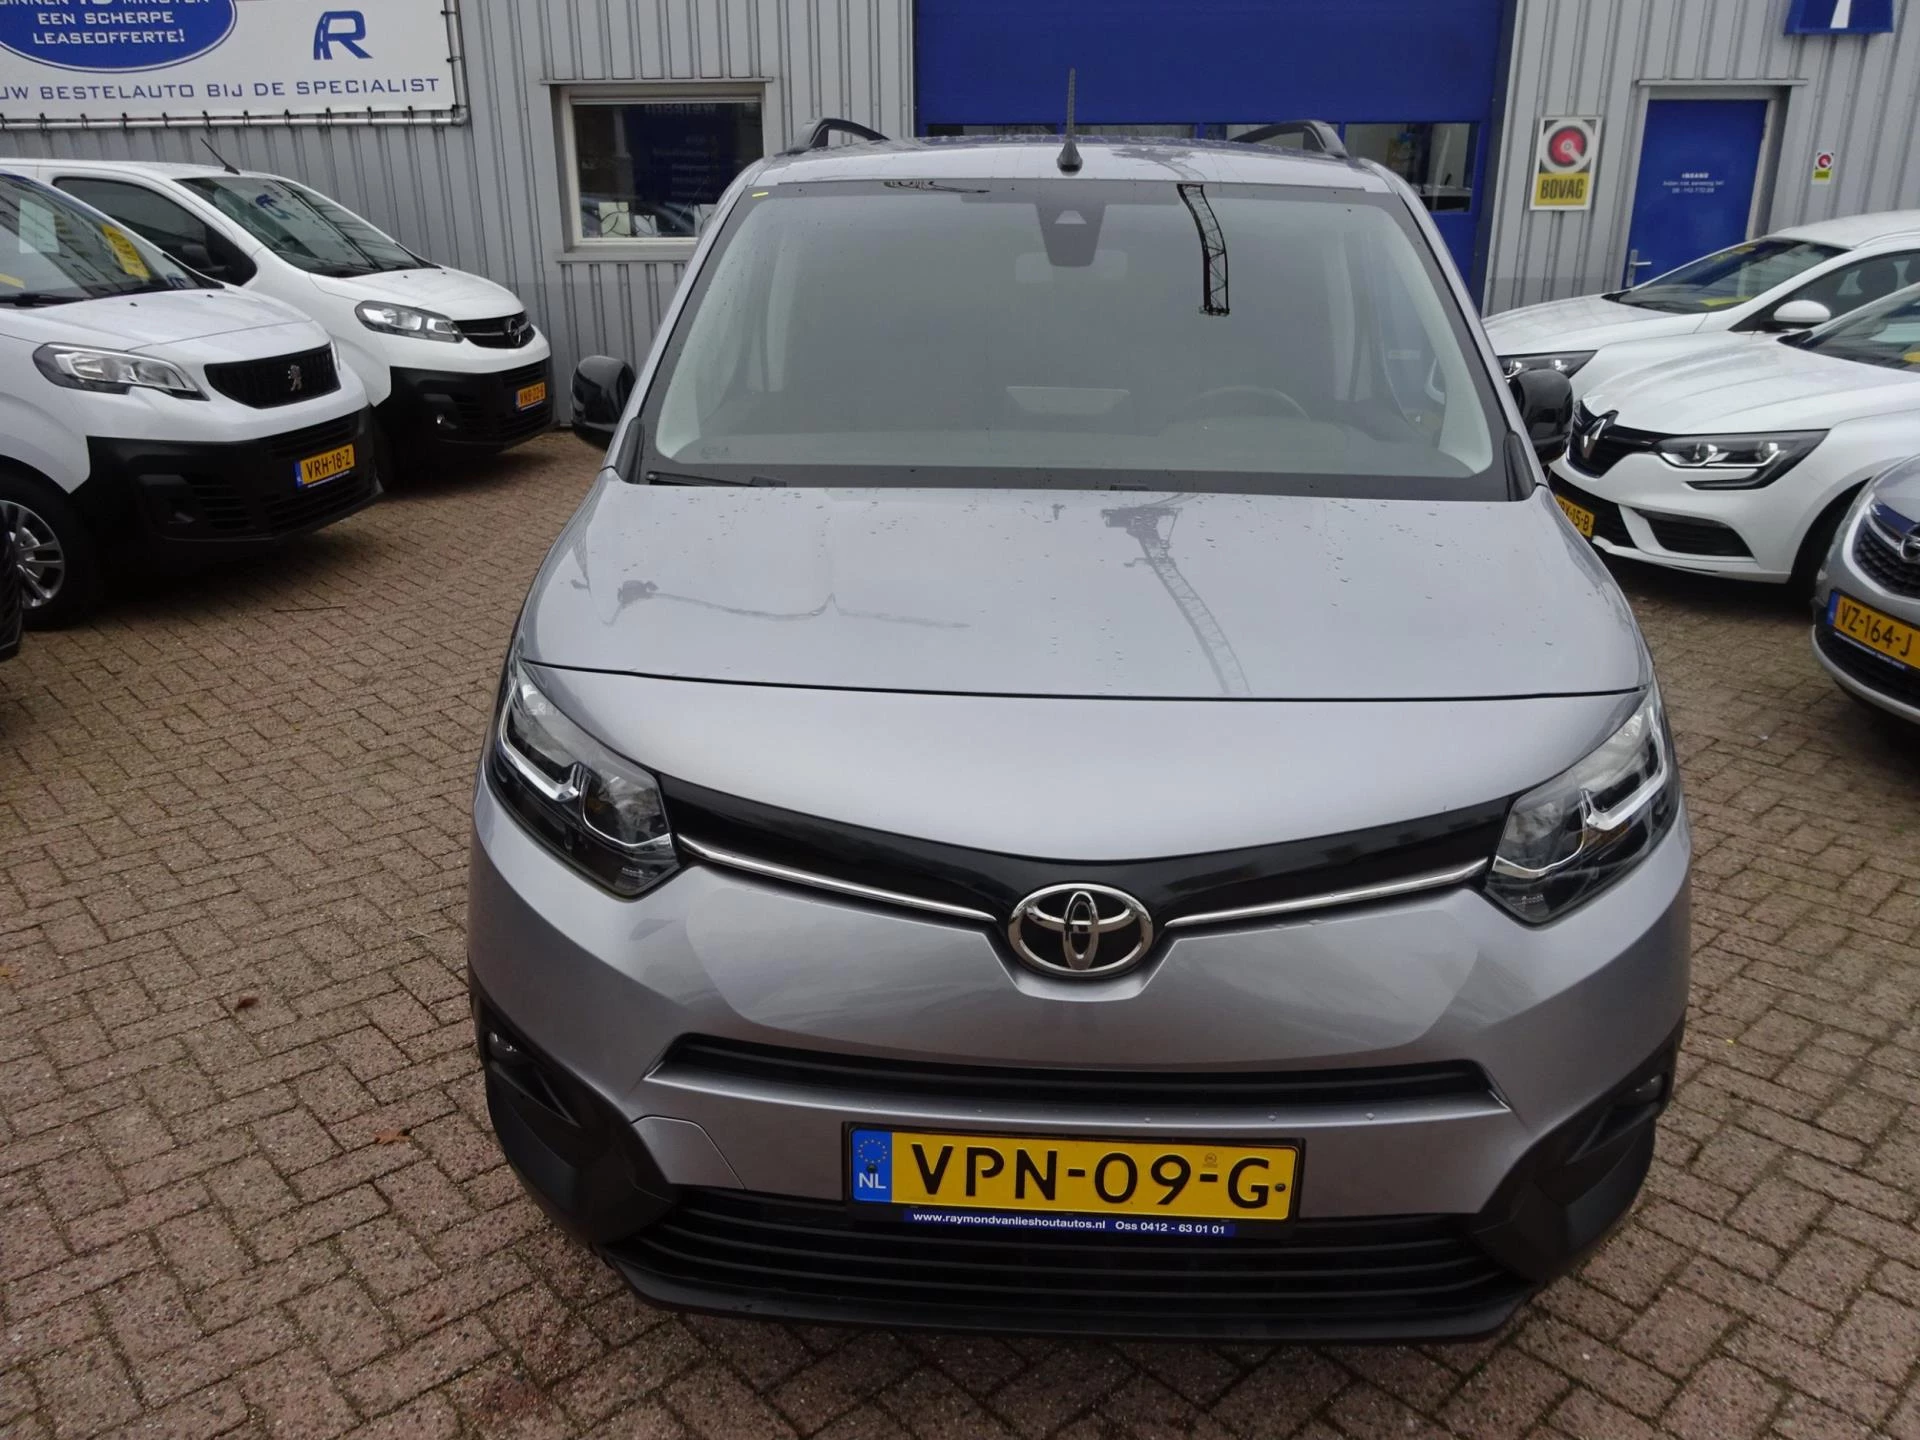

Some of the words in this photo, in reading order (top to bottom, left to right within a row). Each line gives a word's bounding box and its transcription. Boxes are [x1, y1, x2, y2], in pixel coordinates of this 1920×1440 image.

[37, 13, 76, 25] EEN
[84, 11, 174, 24] SCHERPE
[32, 28, 186, 45] LEASEOFFERTE!
[40, 84, 194, 100] BESTELAUTO
[206, 84, 243, 97] BIJ
[254, 82, 286, 96] DE
[296, 78, 439, 95] SPECIALIST
[1540, 178, 1585, 200] BOVAG
[305, 448, 351, 479] VRH-18-Z
[1841, 601, 1913, 656] VZ-164-J
[858, 1171, 887, 1189] NL
[911, 1143, 1270, 1210] VPN-09-G
[913, 1212, 1106, 1230] www.raymondvanlieshoutautos.nl
[1115, 1220, 1138, 1231] Oss
[1140, 1222, 1168, 1232] 0412
[1178, 1224, 1193, 1233] 63
[1195, 1225, 1208, 1234] 01
[1211, 1225, 1225, 1235] 01
